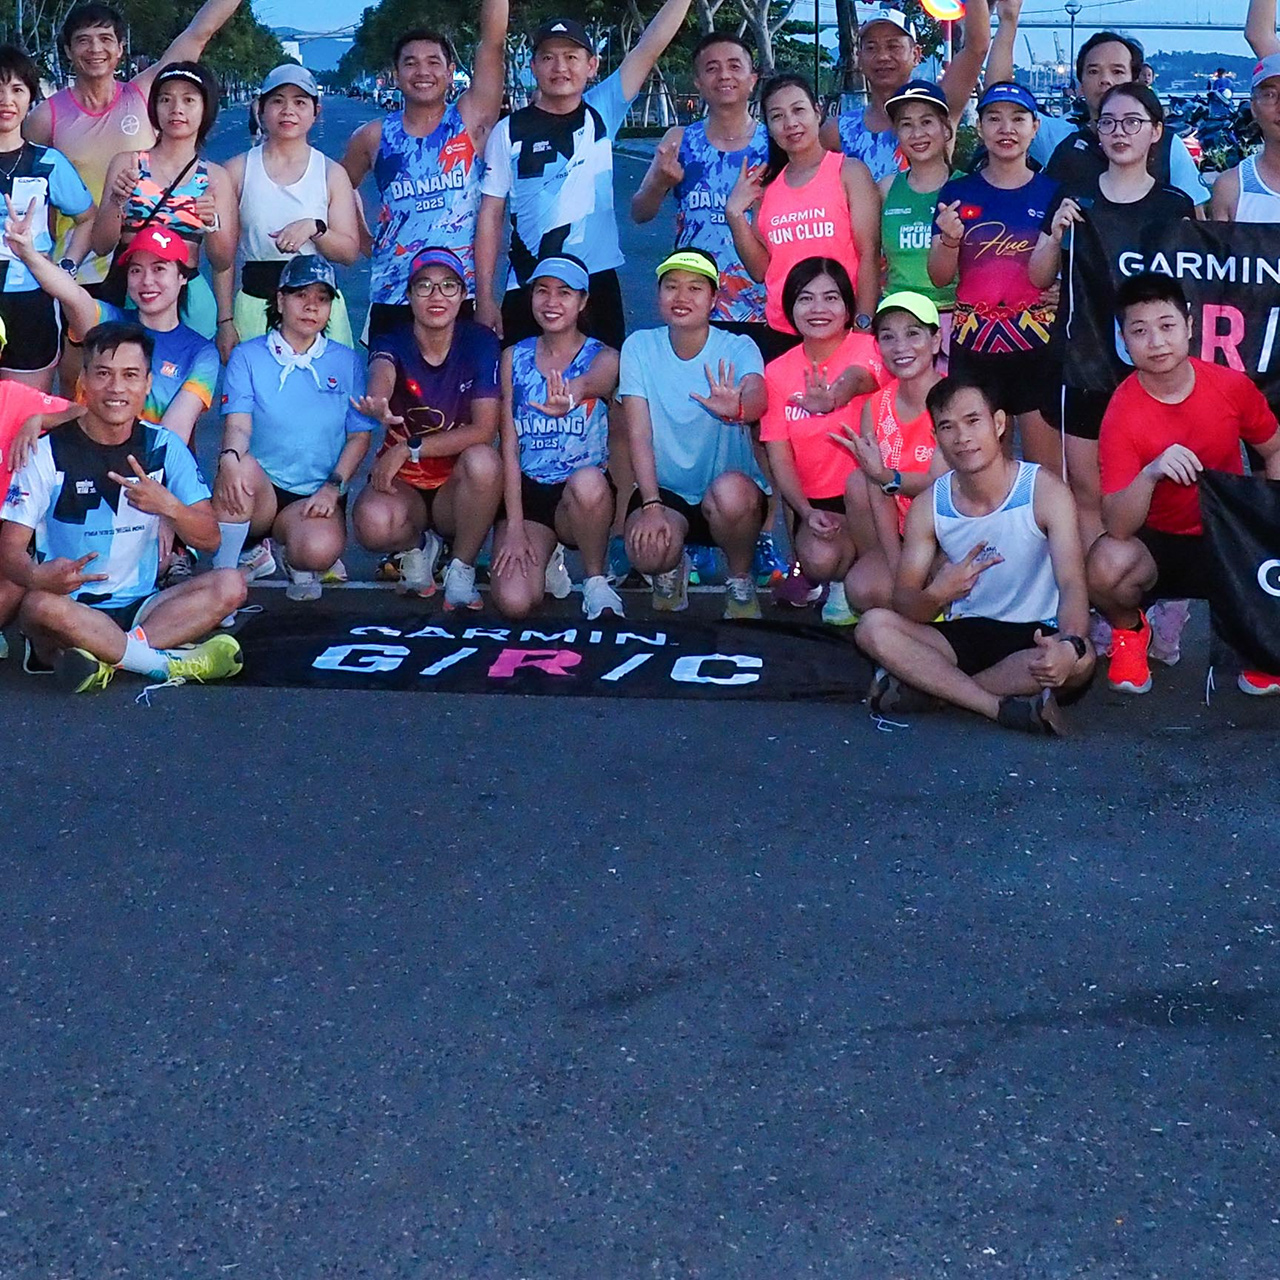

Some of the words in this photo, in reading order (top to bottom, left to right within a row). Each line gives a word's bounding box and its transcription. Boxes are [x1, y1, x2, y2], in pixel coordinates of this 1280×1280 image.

[414, 197, 446, 212] 2025
[770, 207, 826, 226] GARMIN
[795, 221, 835, 241] CLUB
[900, 225, 932, 234] IMPERIA
